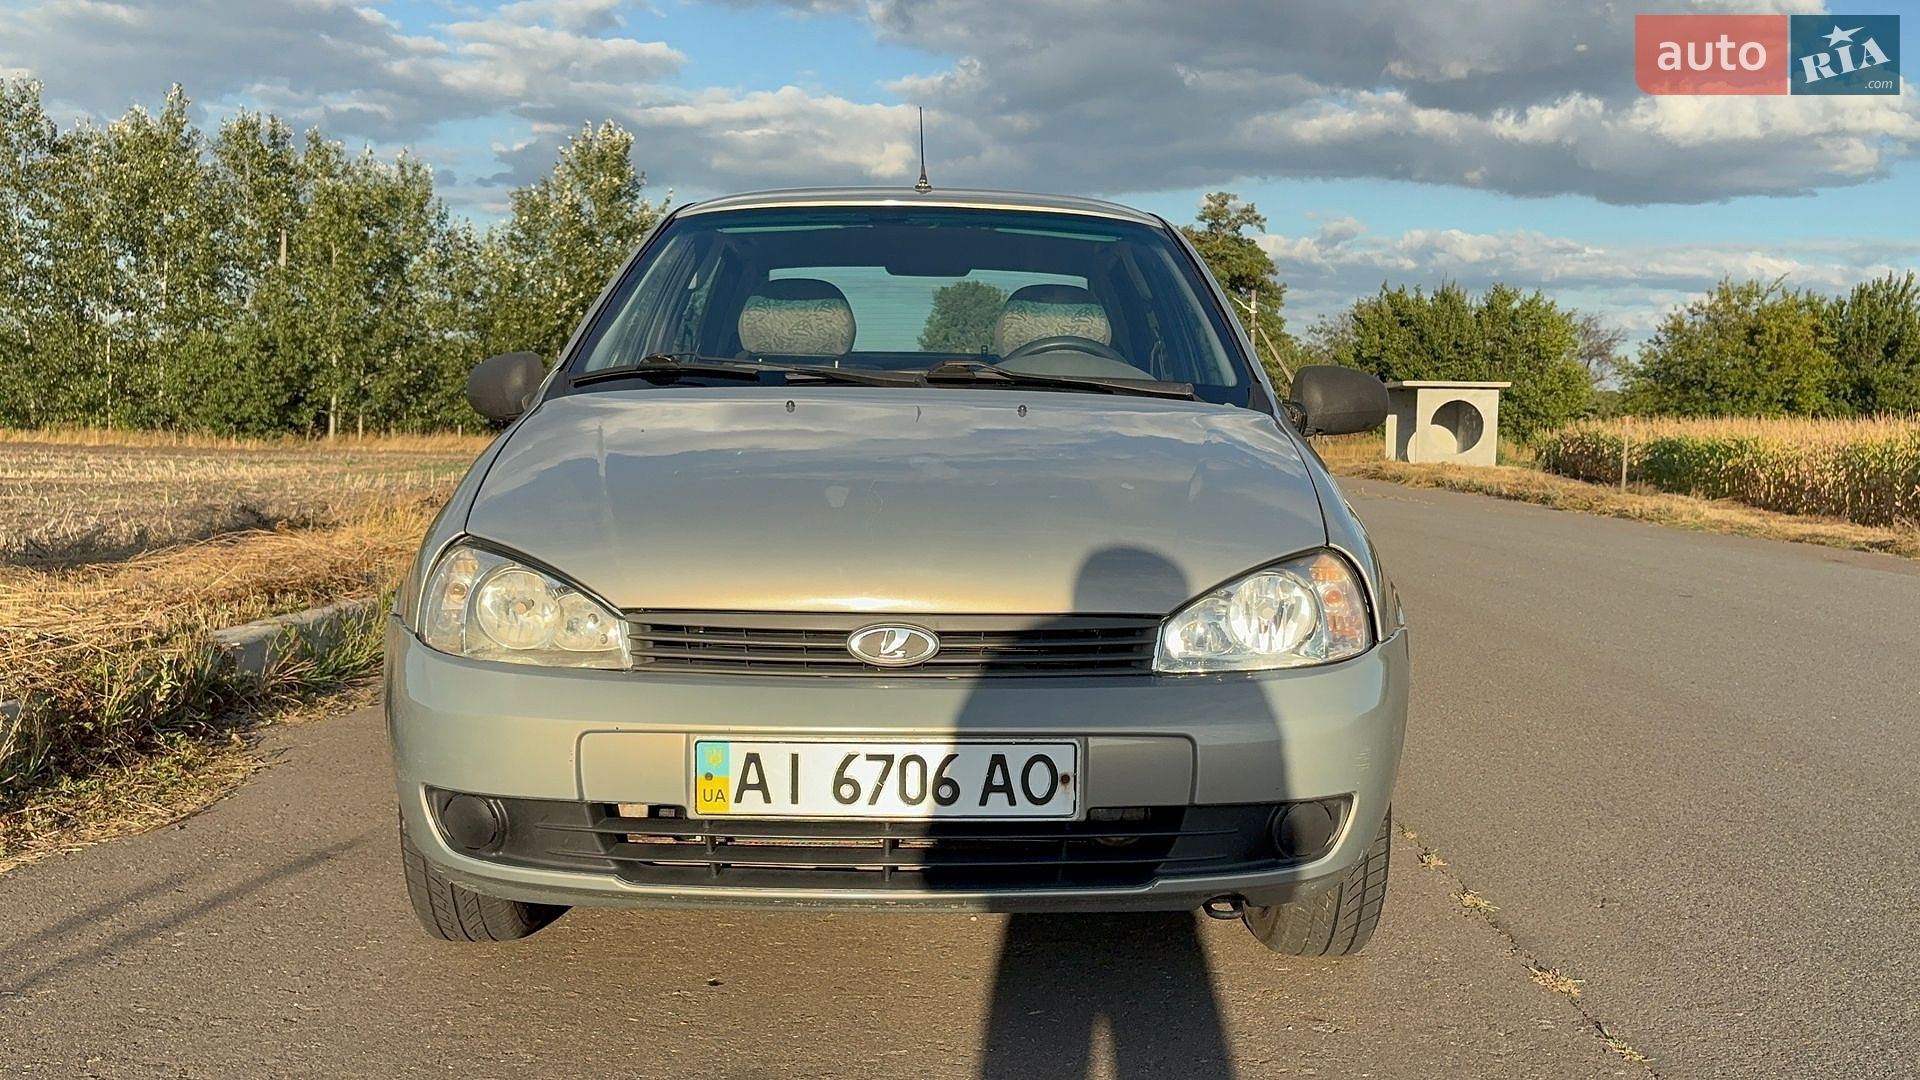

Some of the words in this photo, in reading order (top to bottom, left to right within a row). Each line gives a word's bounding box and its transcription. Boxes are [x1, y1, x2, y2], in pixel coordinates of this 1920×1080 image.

[703, 788, 726, 803] UA
[734, 752, 799, 805] AI
[832, 753, 961, 806] 6706
[979, 753, 1058, 807] AO
